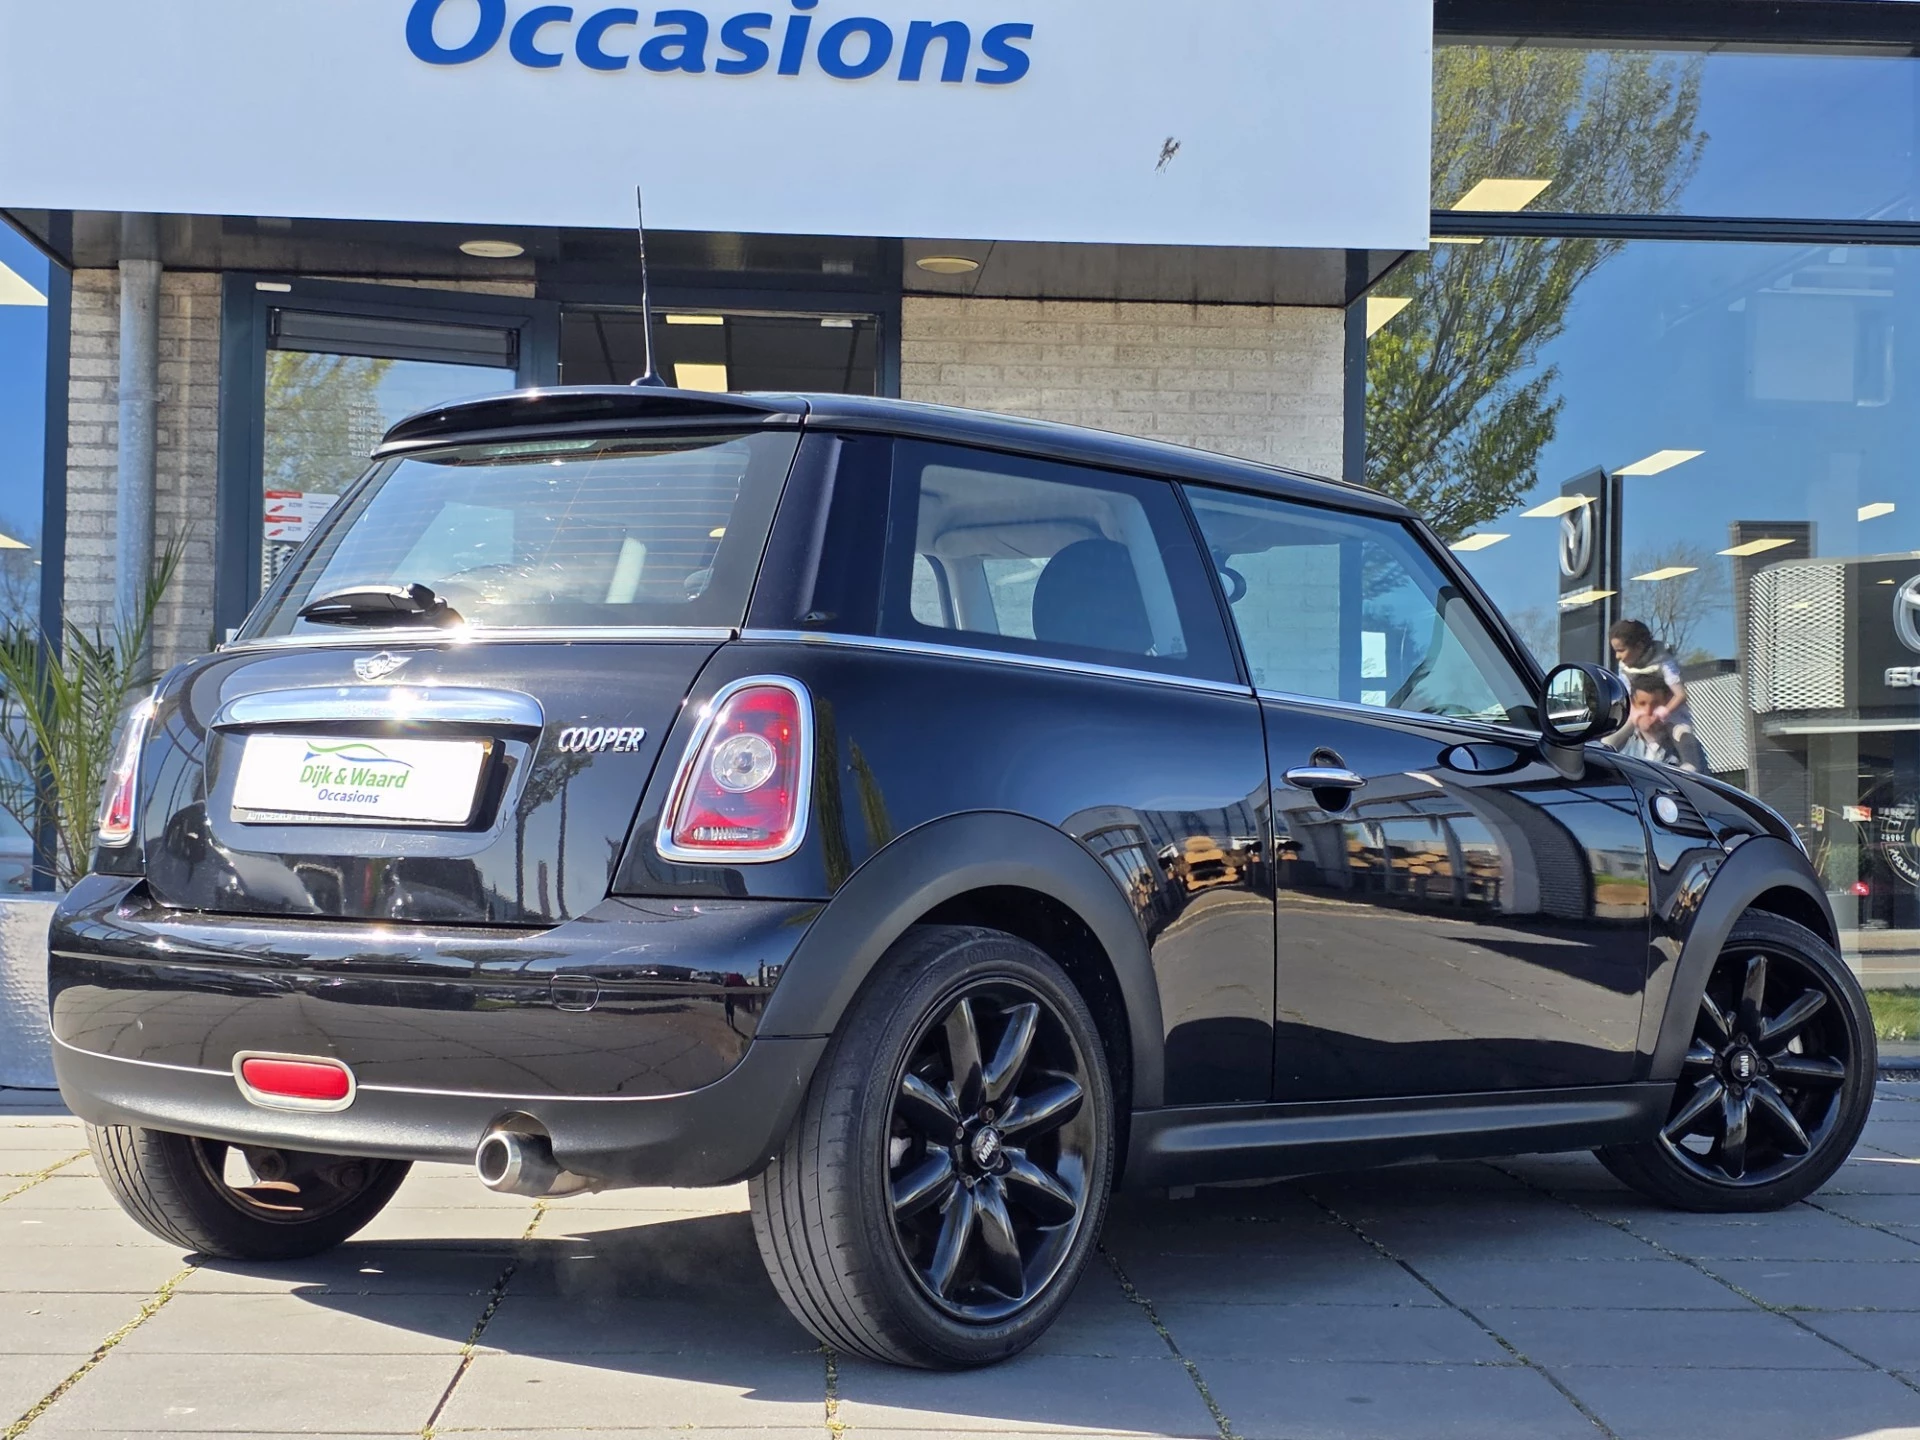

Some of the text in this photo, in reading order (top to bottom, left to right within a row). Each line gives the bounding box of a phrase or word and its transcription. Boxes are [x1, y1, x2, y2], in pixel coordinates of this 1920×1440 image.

[405, 0, 1034, 85] Occasions
[558, 727, 647, 753] COOPER
[299, 765, 410, 788] Dijk & Waard
[318, 788, 380, 804] Occasions
[1740, 1055, 1749, 1077] MINI
[979, 1131, 998, 1164] MINI
